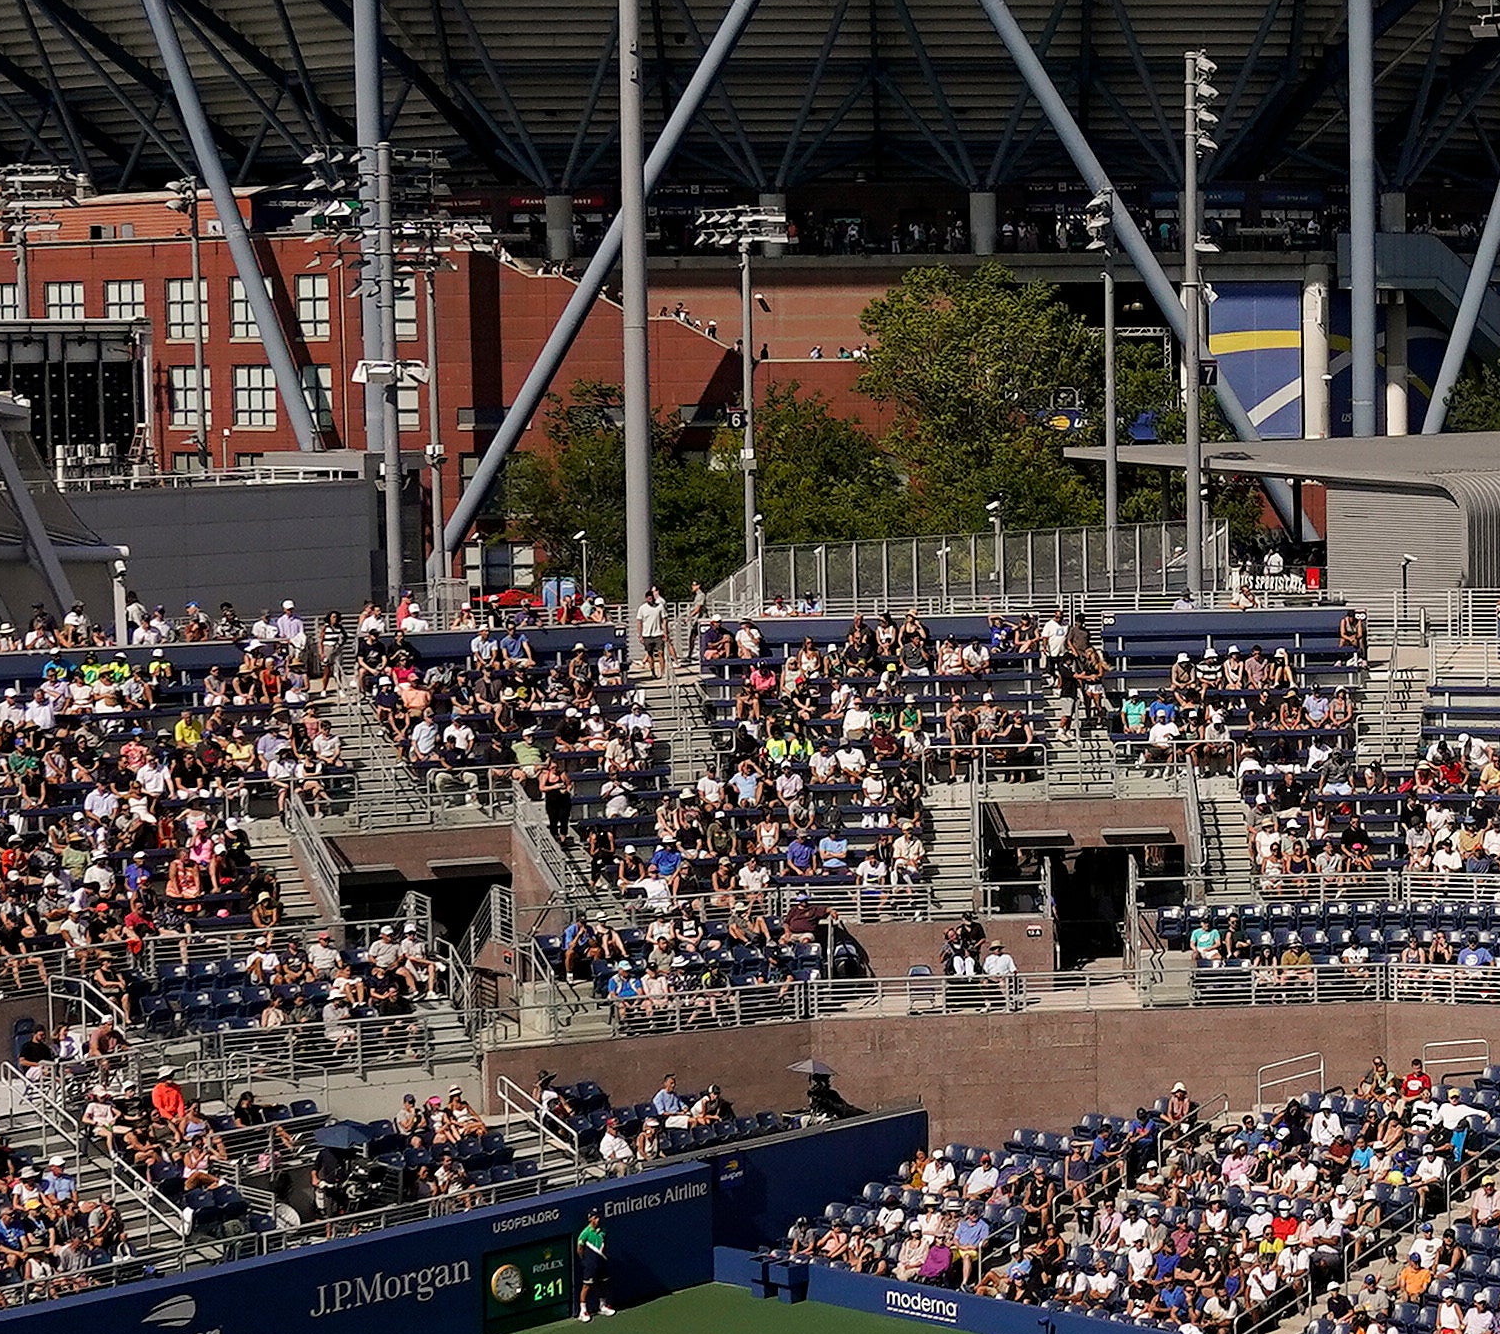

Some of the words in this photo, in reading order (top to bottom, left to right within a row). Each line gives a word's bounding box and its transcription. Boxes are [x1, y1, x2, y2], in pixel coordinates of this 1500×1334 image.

[1205, 367, 1213, 384] 7
[732, 414, 740, 427] 6
[604, 1191, 661, 1218] Emirates
[663, 1182, 708, 1203] Airline
[492, 1209, 560, 1234] USOPEN.ORG
[532, 1259, 564, 1274] ROLEX
[309, 1259, 472, 1318] J.P.Morgan
[534, 1278, 563, 1301] 2:41
[886, 1290, 958, 1318] moderna
